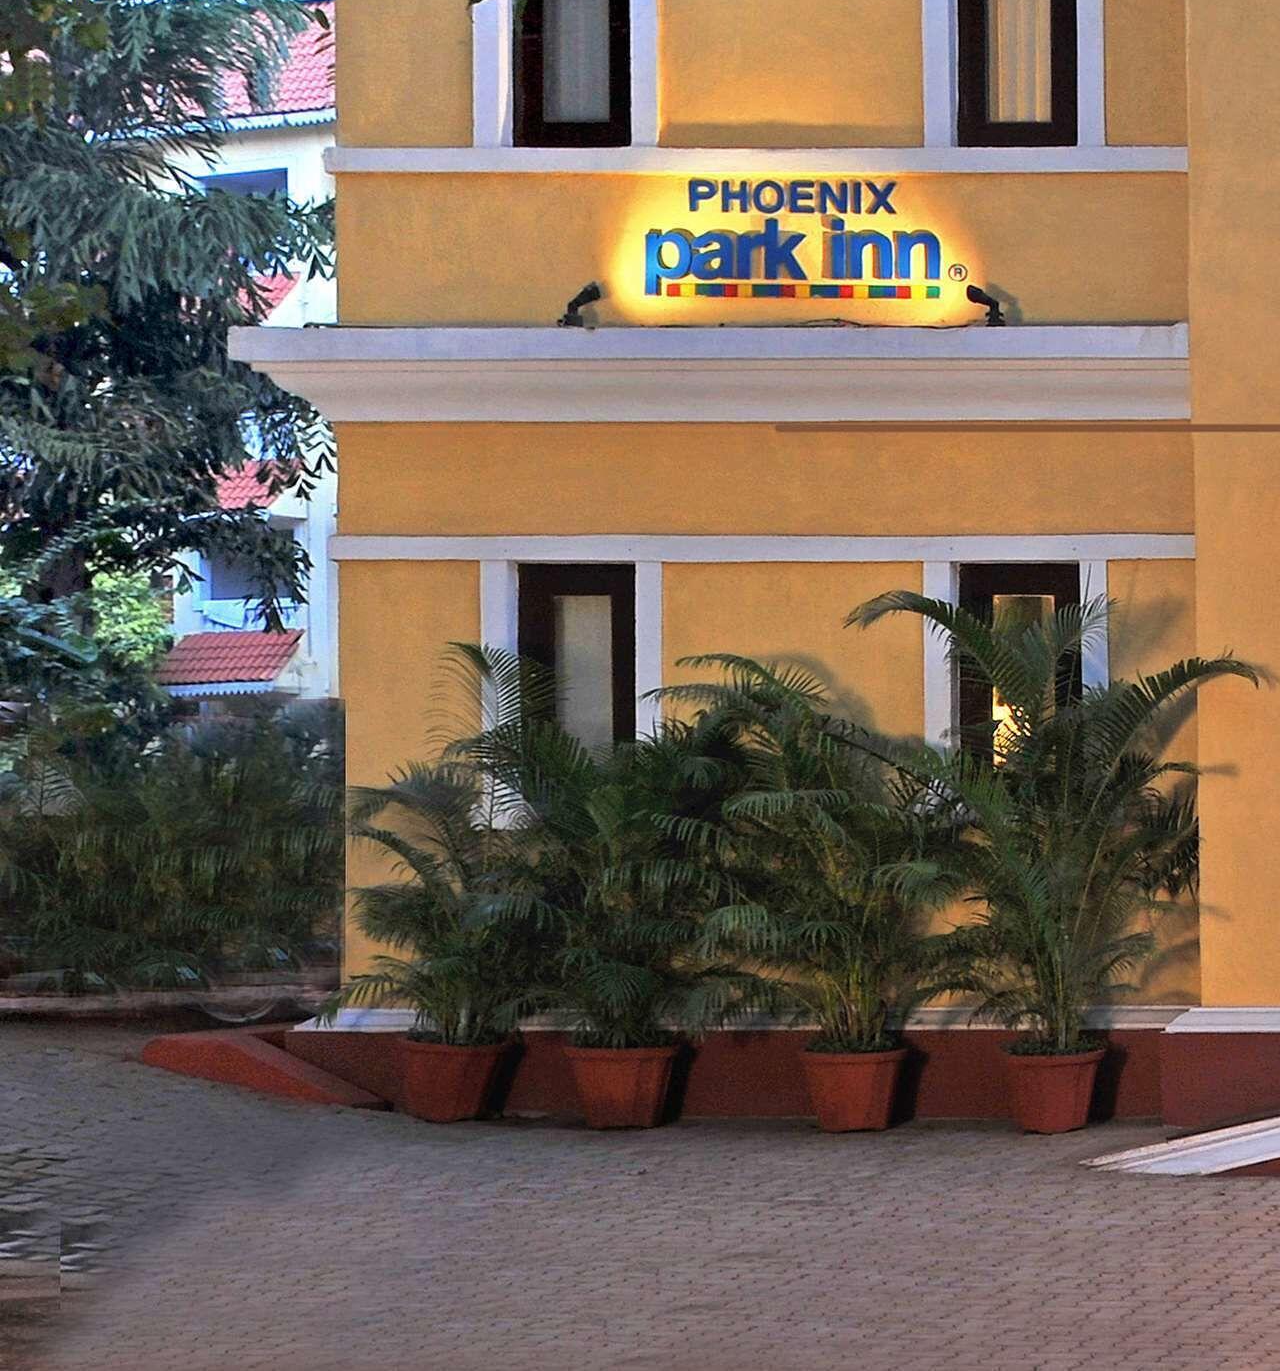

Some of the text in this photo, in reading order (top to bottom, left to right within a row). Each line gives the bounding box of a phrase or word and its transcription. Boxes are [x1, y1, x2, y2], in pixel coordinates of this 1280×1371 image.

[687, 178, 898, 215] PHOENIX
[644, 214, 941, 297] park inn
